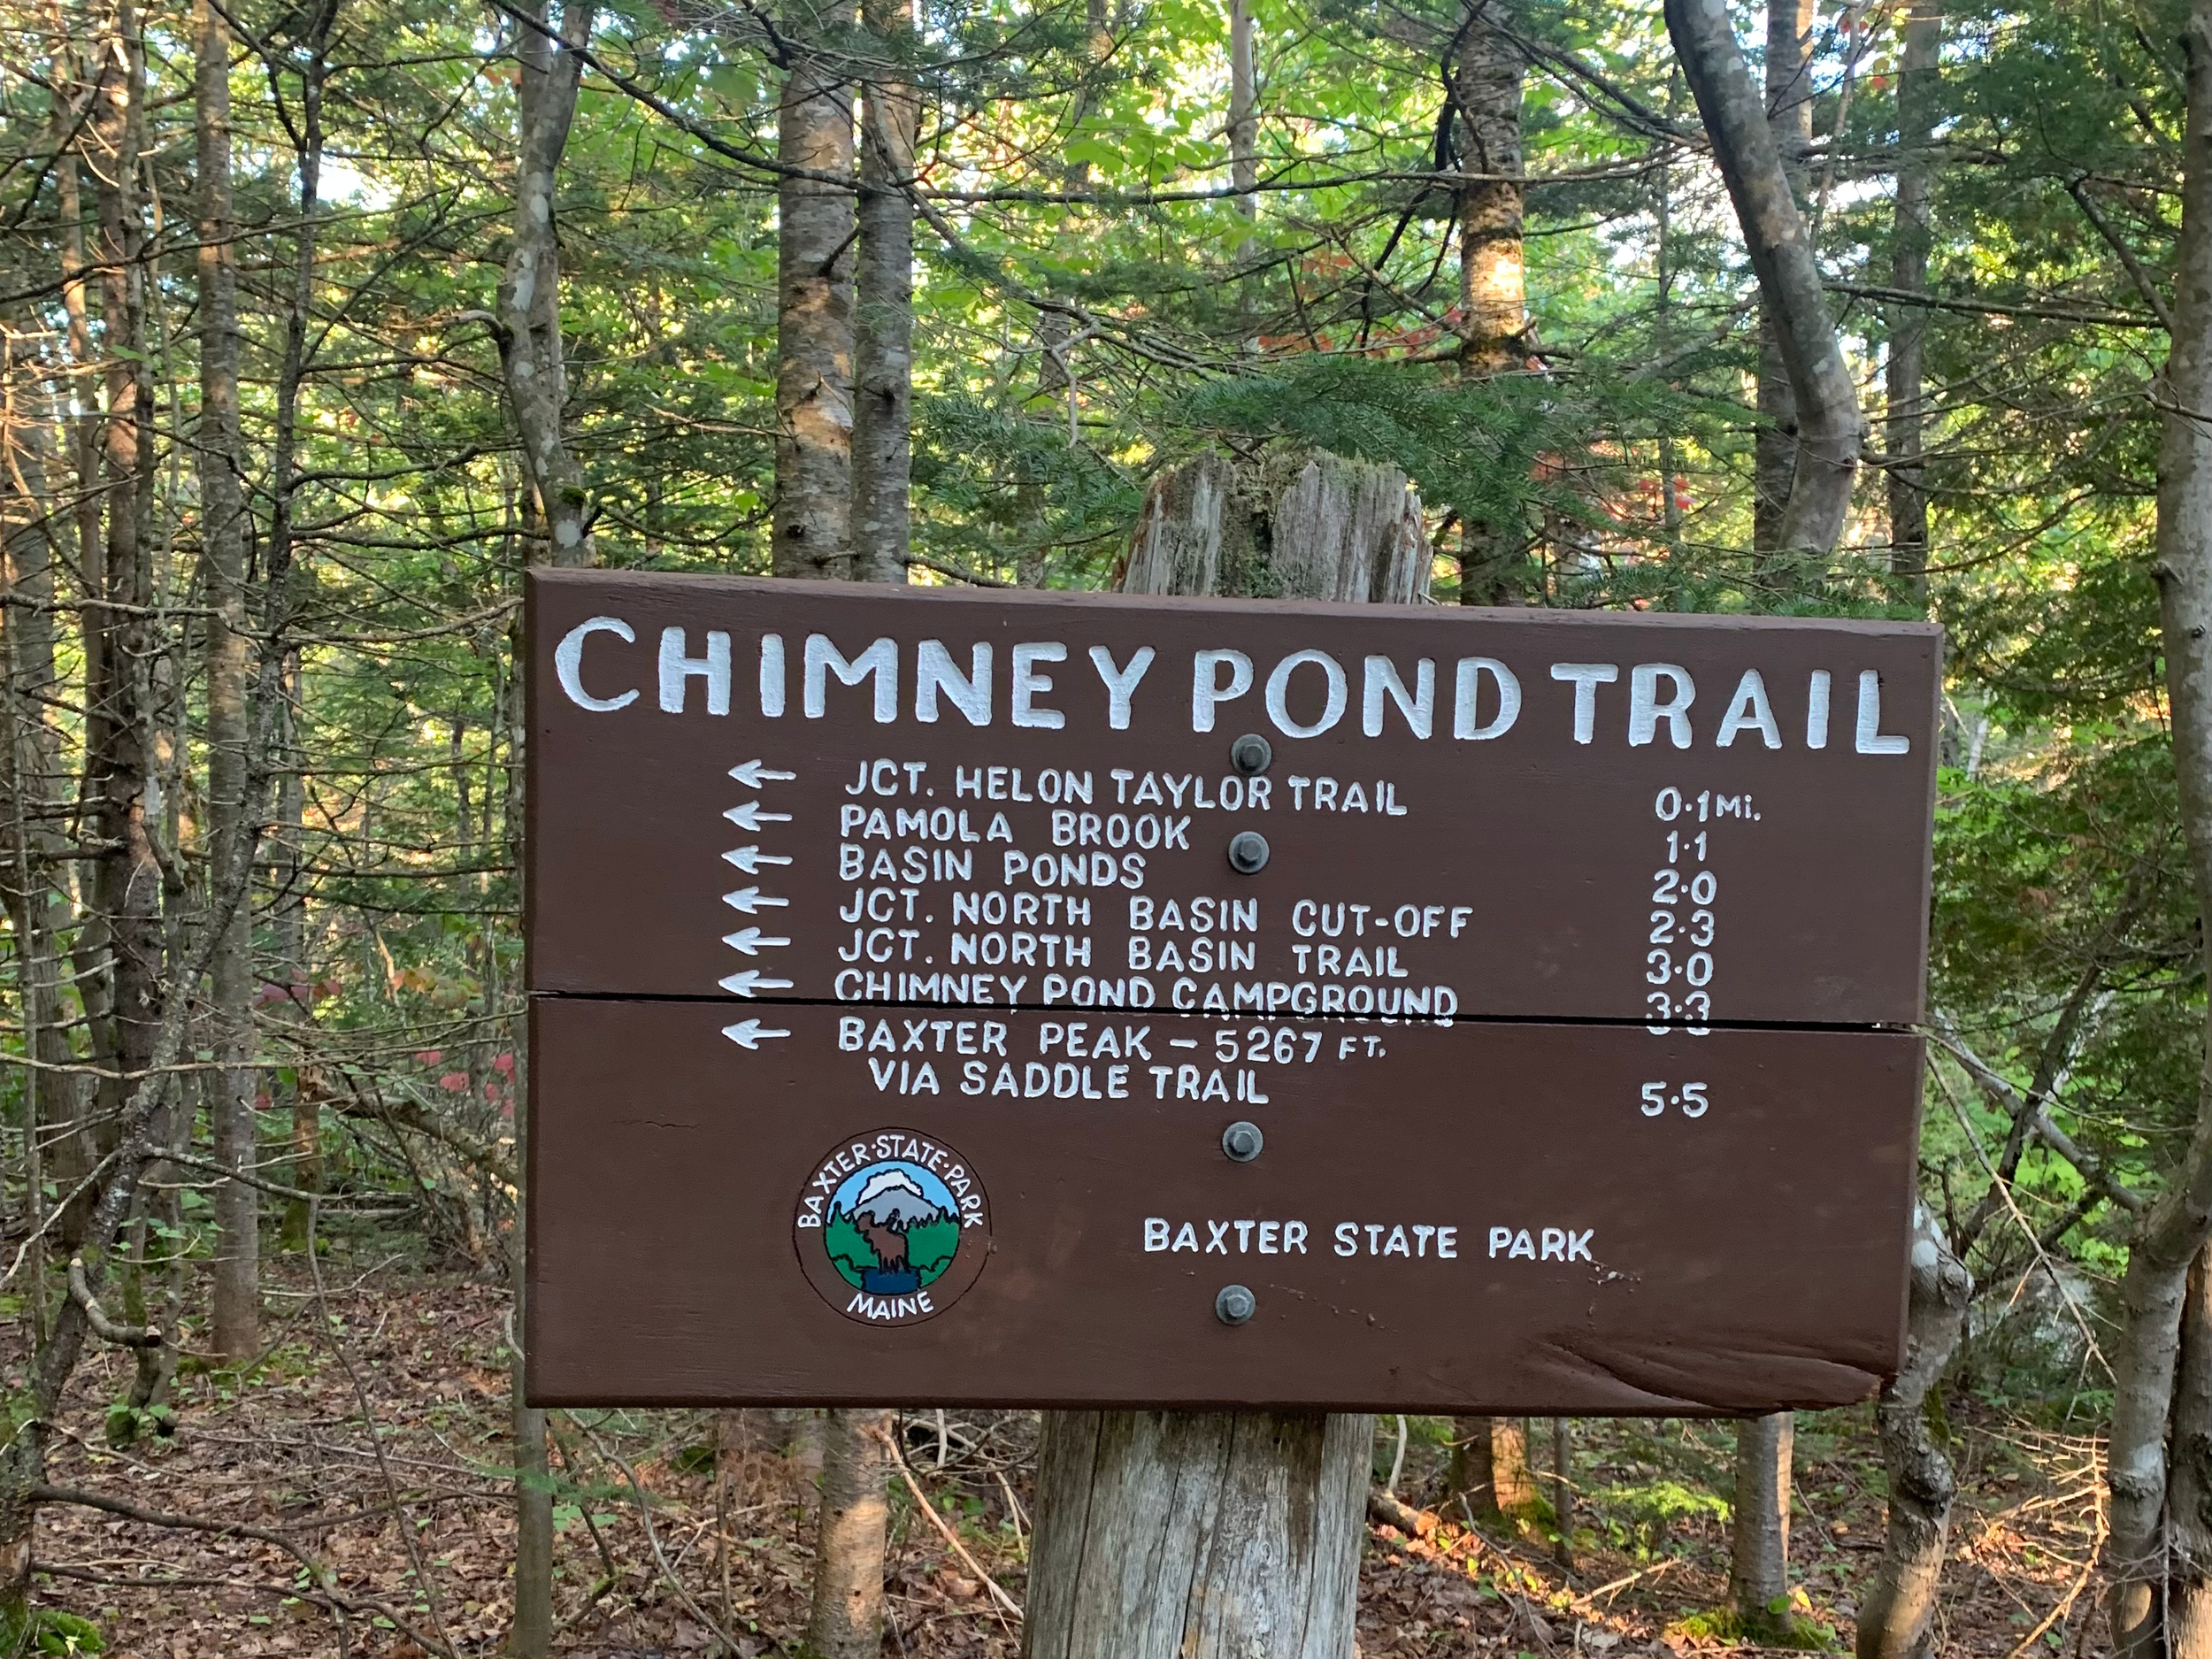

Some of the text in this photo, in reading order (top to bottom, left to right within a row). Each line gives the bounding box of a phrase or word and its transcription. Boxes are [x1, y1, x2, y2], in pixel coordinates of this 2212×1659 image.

[554, 616, 1910, 755] CHIMNEY POND TRAIL
[845, 758, 1408, 816] JCT. HELON TAYLOR TRAIL
[841, 803, 1191, 850] PAMOLA BROOK
[839, 842, 1147, 890] BASIN PONDS
[839, 887, 1473, 939] JCT. NORTH BASIN CUT-OFF
[837, 927, 1409, 978] JCT. NORTH BASIN TRAIL
[834, 968, 1458, 1028] CHIMNEY POND CAMPGROUND
[838, 1016, 1007, 1057] BAXTER
[1039, 1022, 1152, 1062] PEAK
[1215, 1025, 1323, 1064] 5267
[1338, 1035, 1386, 1060] FT.
[868, 1056, 1270, 1104] VIA SADDLE TRAIL
[1144, 1217, 1594, 1263] BAXTER STATE PARK
[846, 1291, 934, 1320] MAINE
